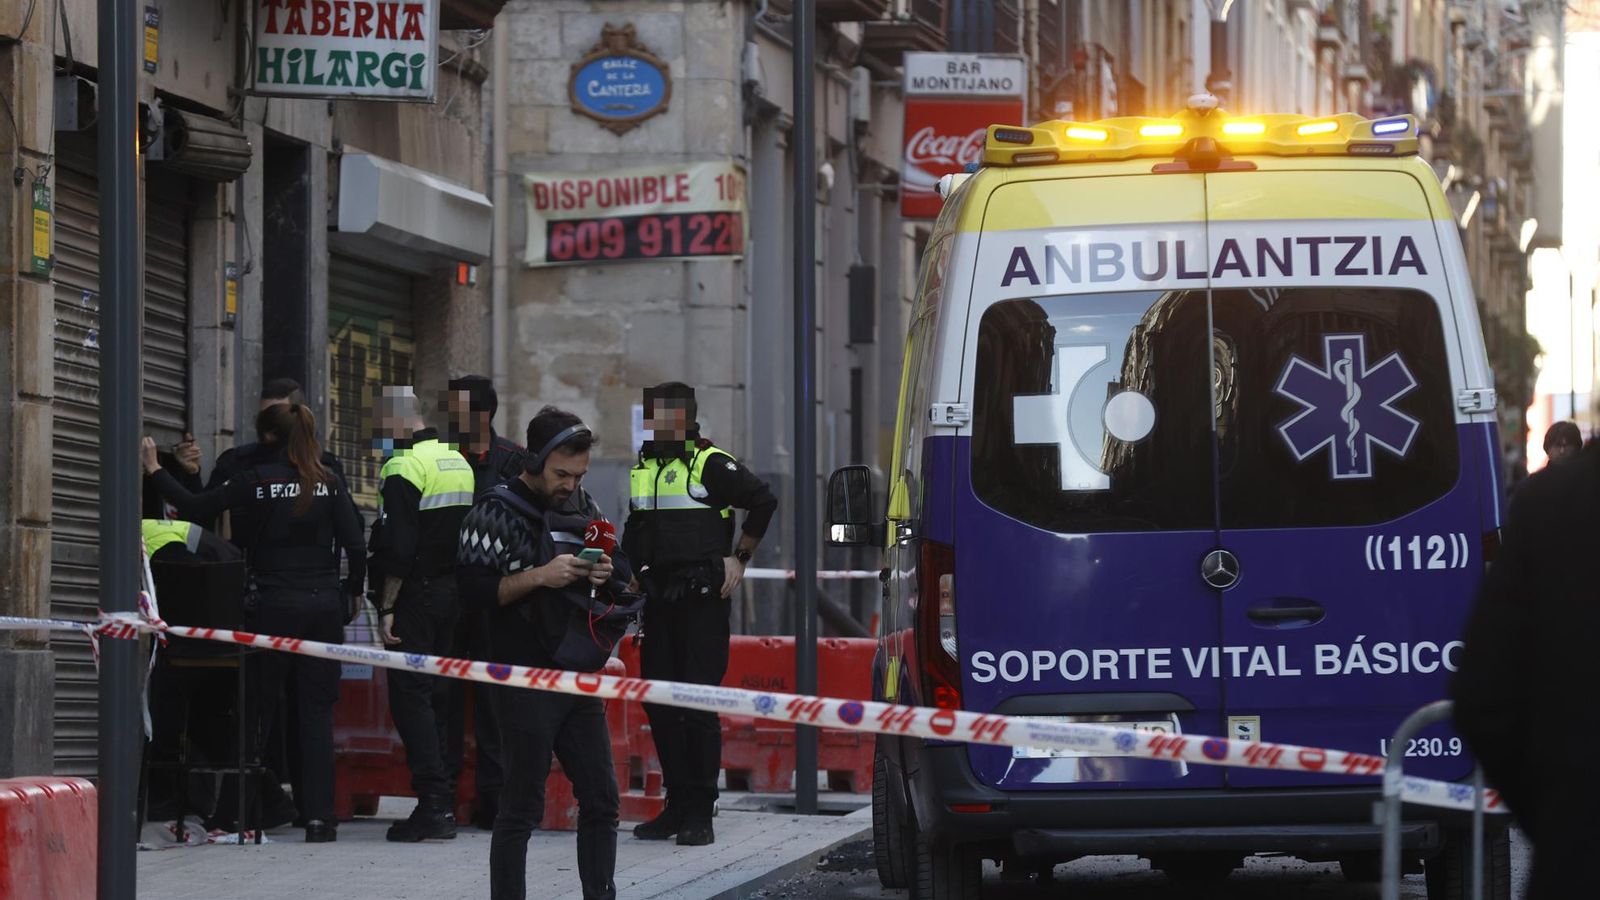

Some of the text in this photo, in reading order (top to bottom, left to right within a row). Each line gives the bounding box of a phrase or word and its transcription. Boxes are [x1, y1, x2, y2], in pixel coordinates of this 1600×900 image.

[261, 0, 425, 41] TABERNA
[602, 60, 637, 70] CALLE
[912, 76, 1013, 90] MONTIJANO
[946, 61, 982, 74] BAR
[532, 173, 690, 212] DISPONIBLE
[550, 217, 626, 260] 609
[1000, 236, 1428, 287] ANBULANTZIA
[971, 647, 1173, 684] SOPORTE
[1182, 645, 1302, 679] VITAL
